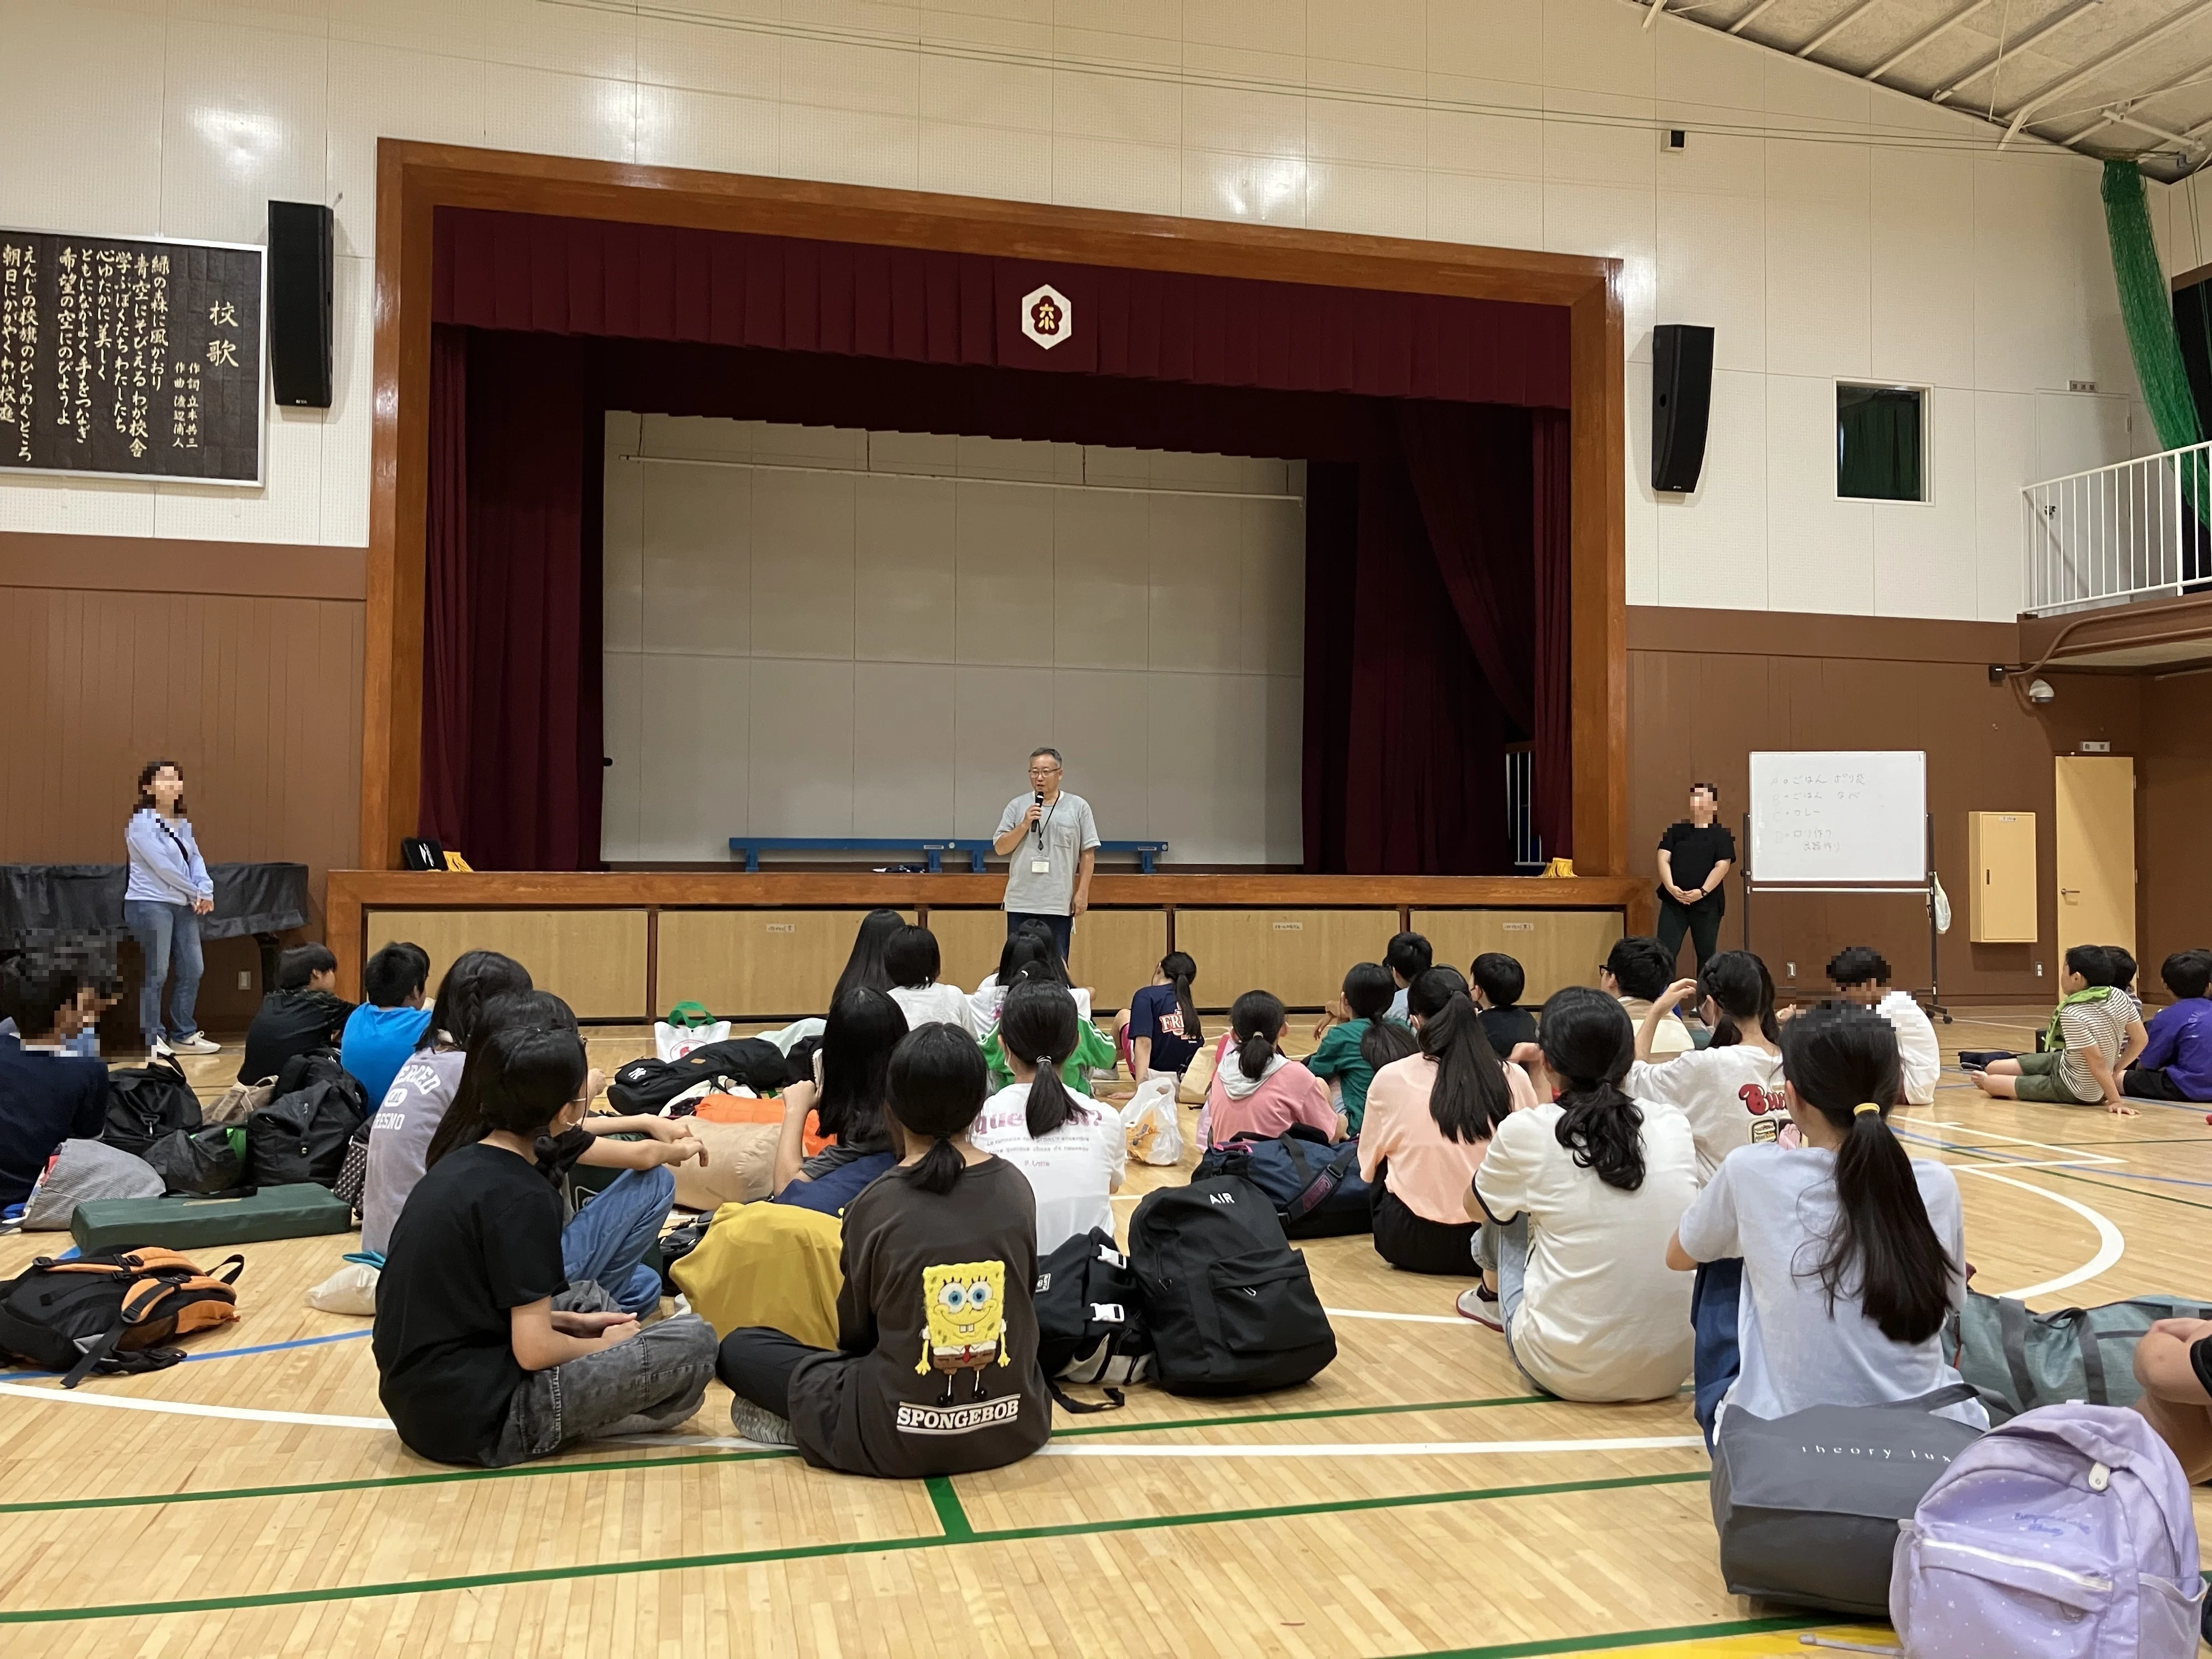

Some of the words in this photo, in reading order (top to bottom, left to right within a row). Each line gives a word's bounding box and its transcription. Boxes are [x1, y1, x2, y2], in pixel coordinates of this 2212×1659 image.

[206, 300, 239, 368] 校歌
[392, 1064, 441, 1095] ERCED
[1209, 1193, 1235, 1204] AIR
[897, 1400, 1019, 1429] SPONGEBOB
[1802, 1444, 1892, 1459] theory
